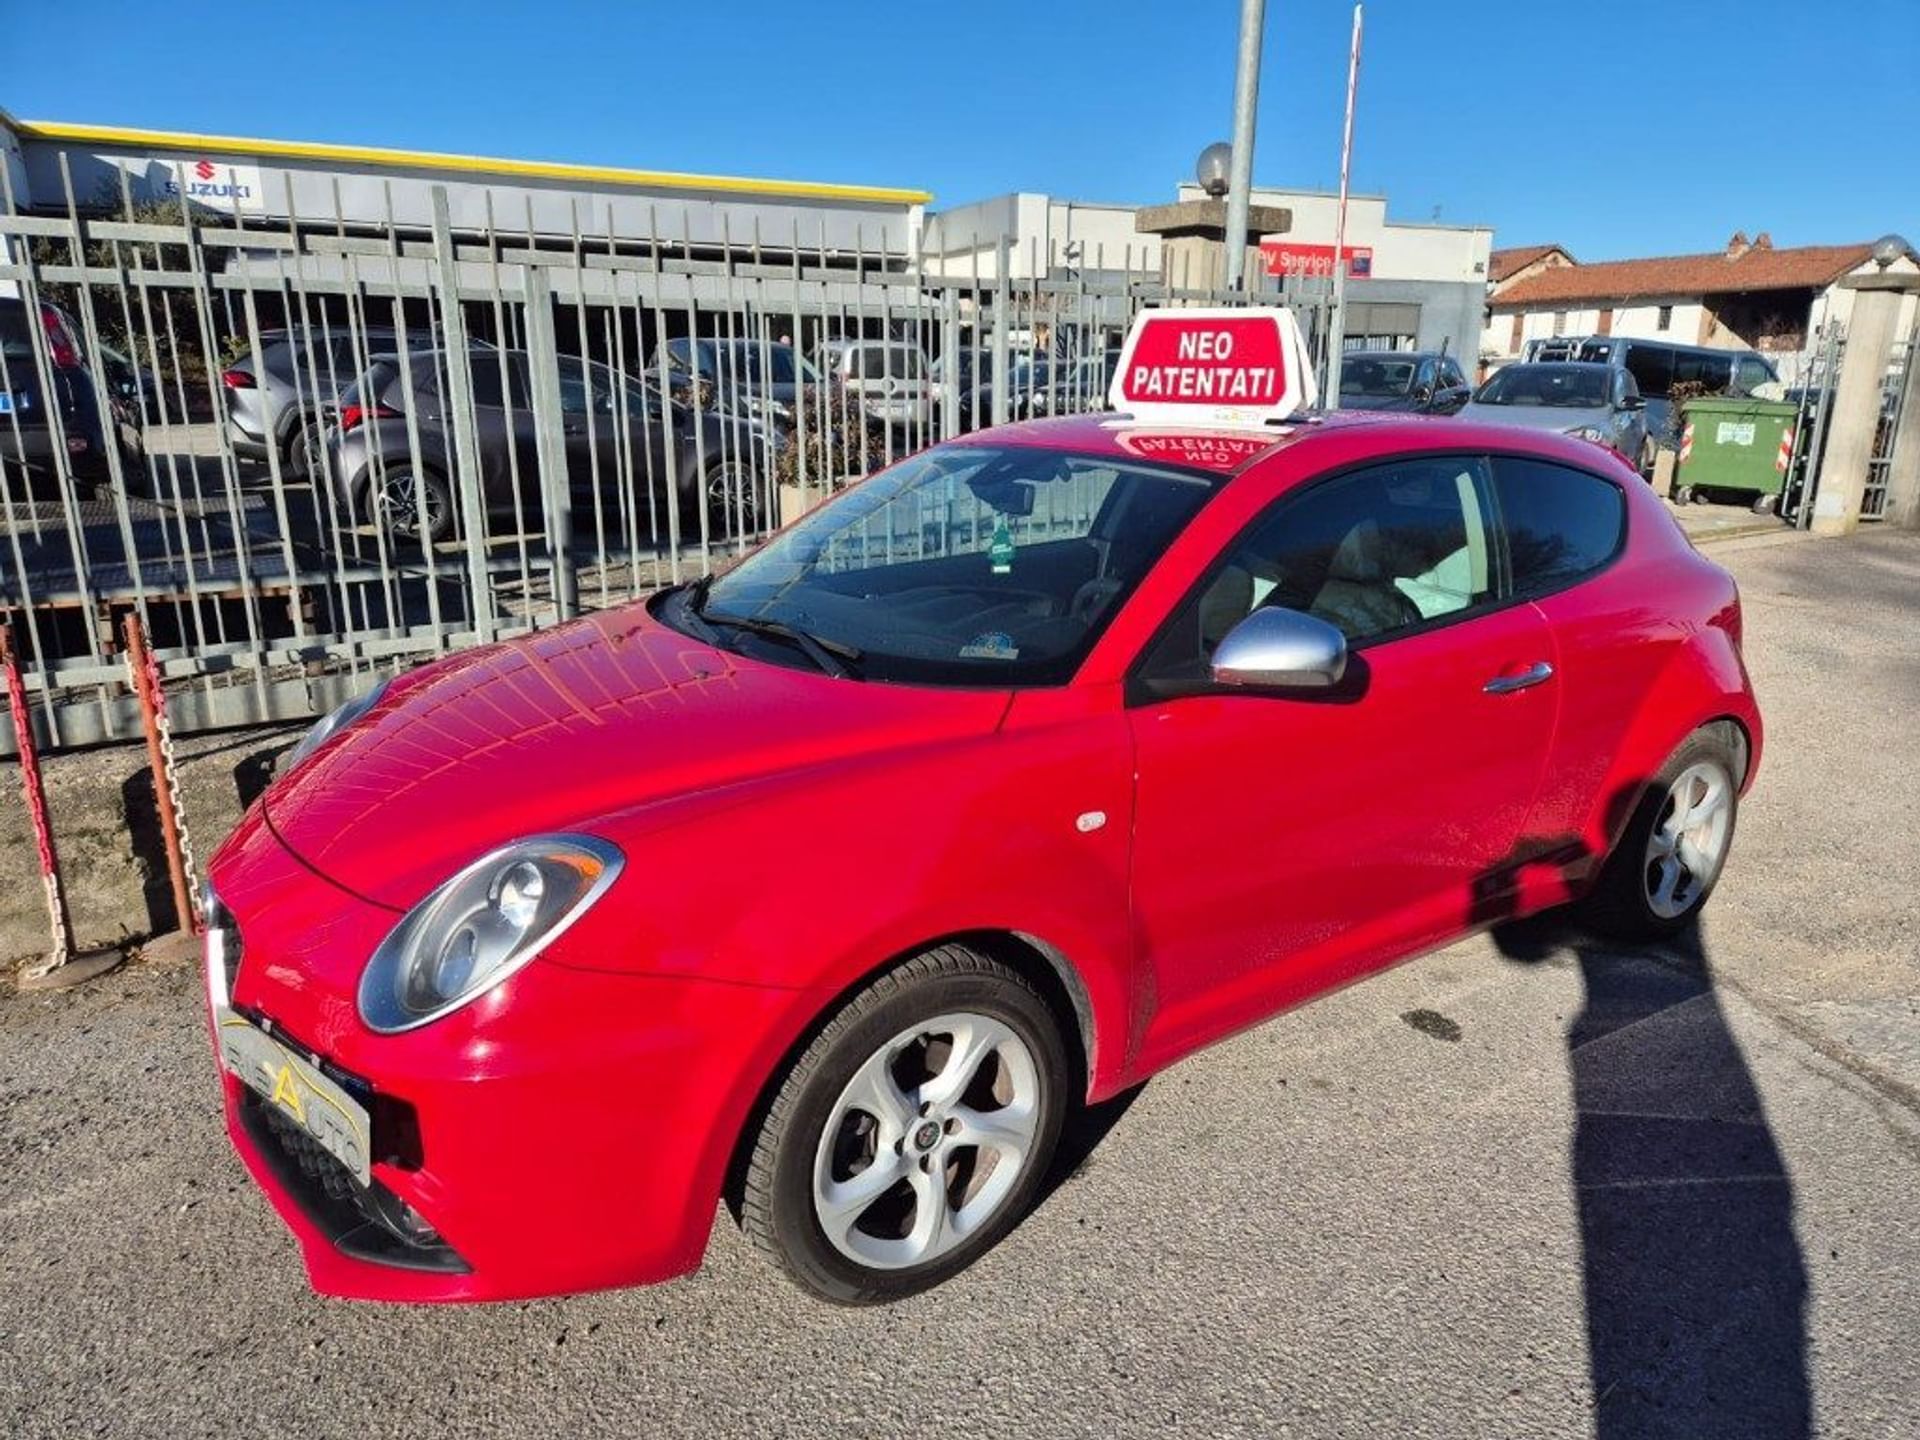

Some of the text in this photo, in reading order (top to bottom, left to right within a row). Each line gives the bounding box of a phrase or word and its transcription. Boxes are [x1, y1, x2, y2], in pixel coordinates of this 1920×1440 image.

[165, 181, 250, 198] SUZUKI
[1178, 331, 1233, 360] NEO
[1132, 366, 1276, 397] PATENTATI
